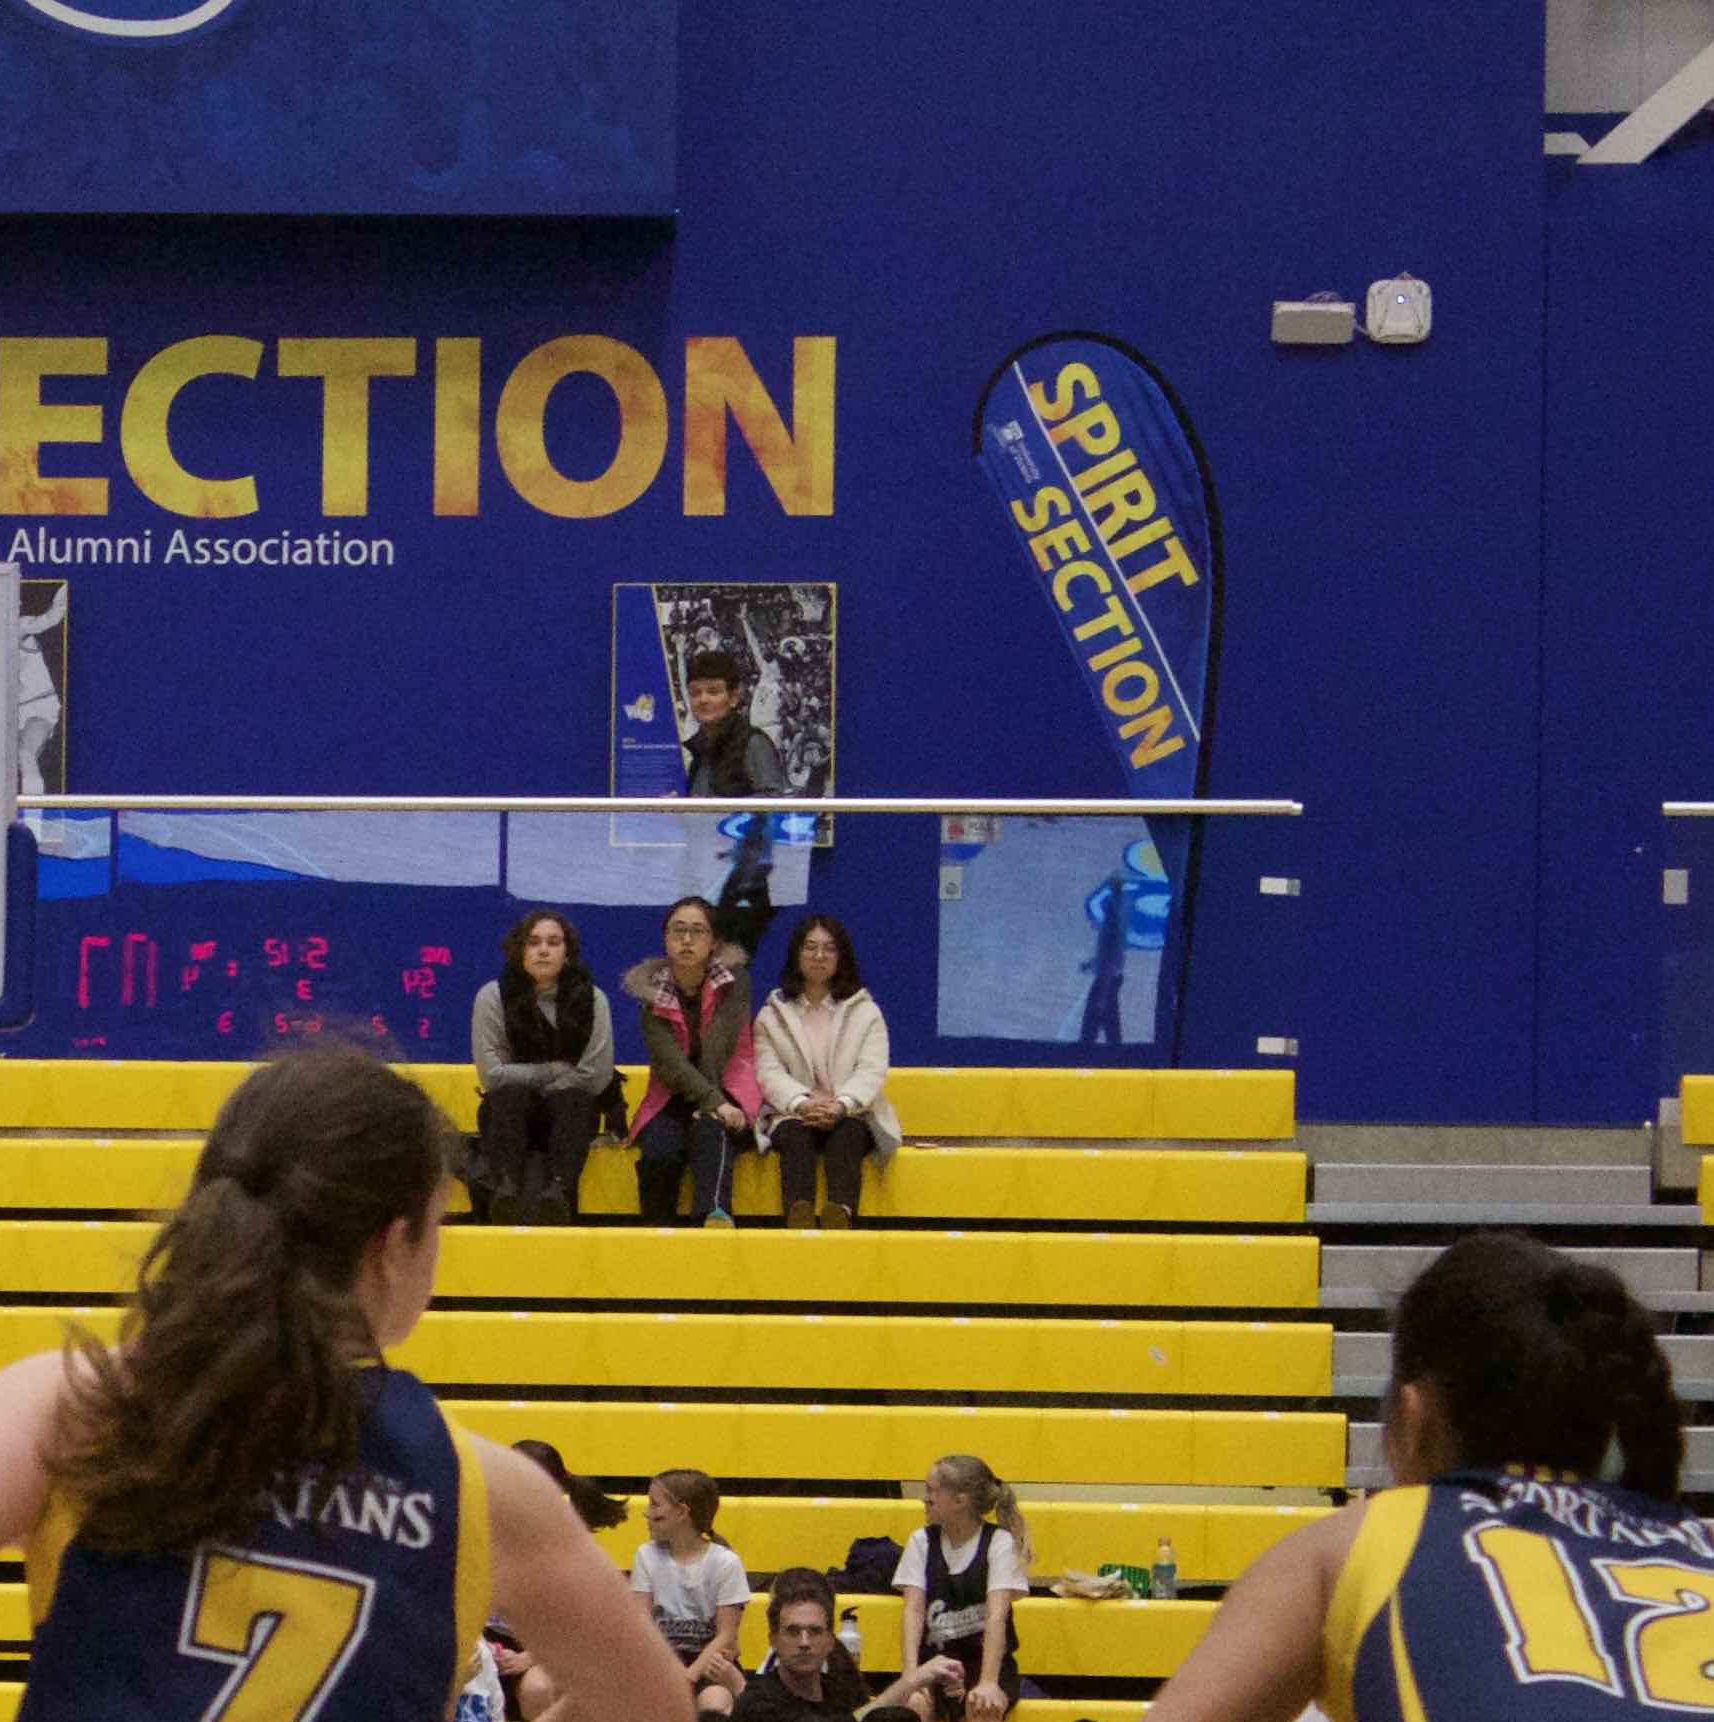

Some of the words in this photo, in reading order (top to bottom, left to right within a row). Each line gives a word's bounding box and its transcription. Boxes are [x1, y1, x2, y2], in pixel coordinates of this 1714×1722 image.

[7, 526, 151, 565] Alumni
[164, 527, 394, 566] Association
[1028, 362, 1199, 597] SPIRIT
[1011, 484, 1186, 770] SECTION
[1462, 1519, 1714, 1714] 12
